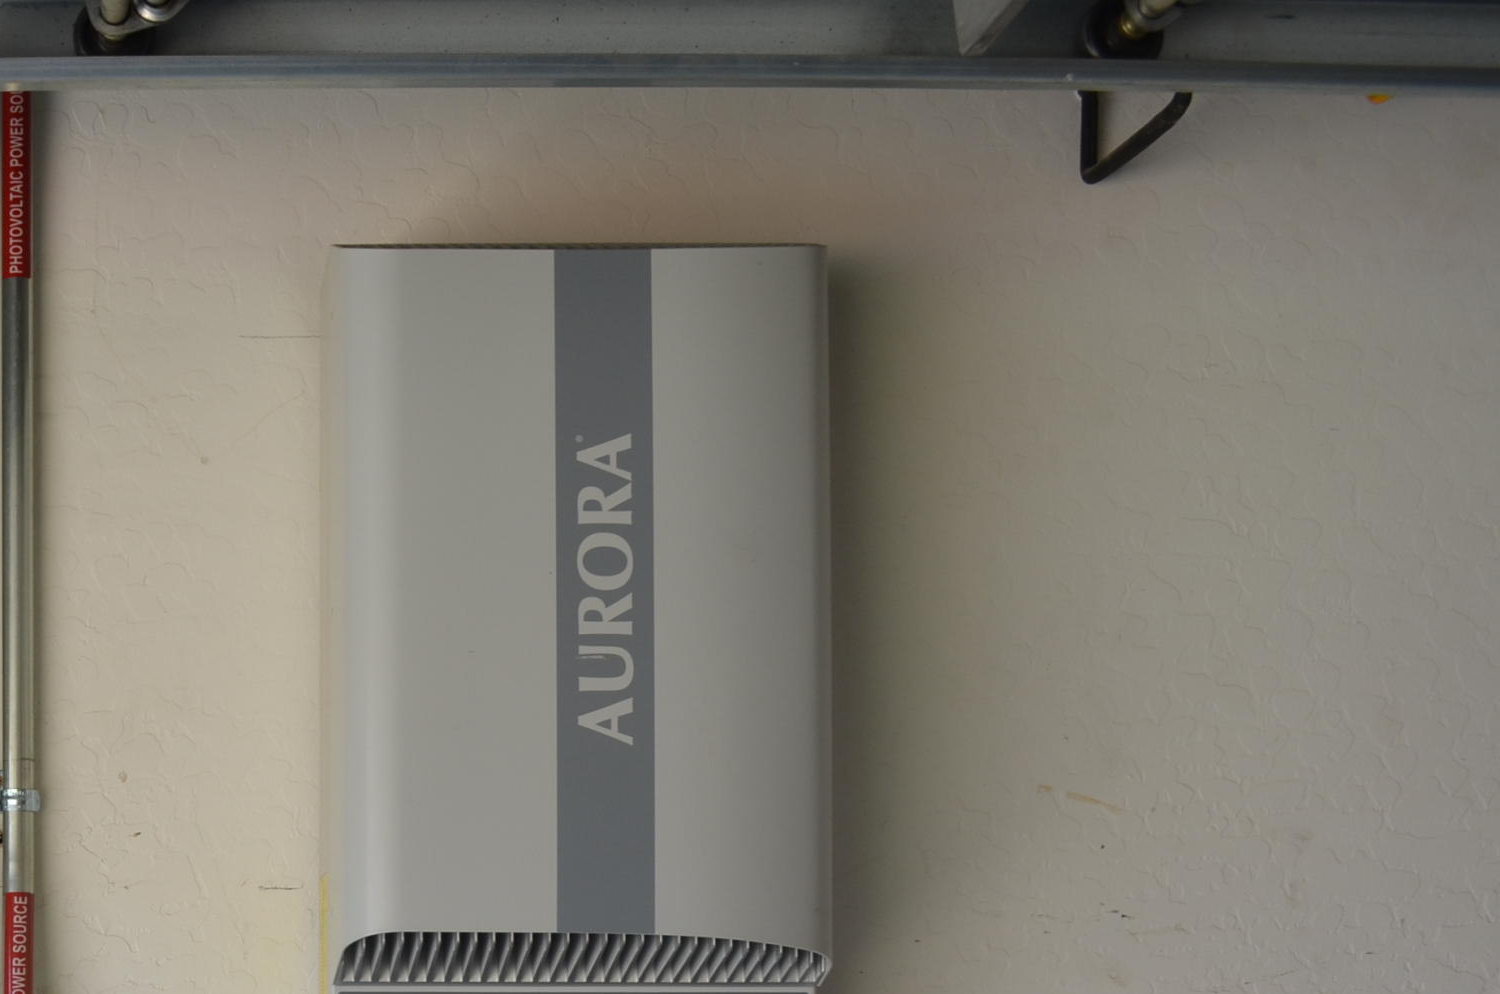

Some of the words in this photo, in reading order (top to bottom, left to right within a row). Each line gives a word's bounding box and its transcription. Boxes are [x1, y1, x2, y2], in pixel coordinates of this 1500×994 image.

[10, 117, 23, 166] POWER
[9, 171, 23, 273] PHOTOVOLTAIC
[576, 433, 634, 745] AURORA
[13, 896, 28, 953] SOURCE
